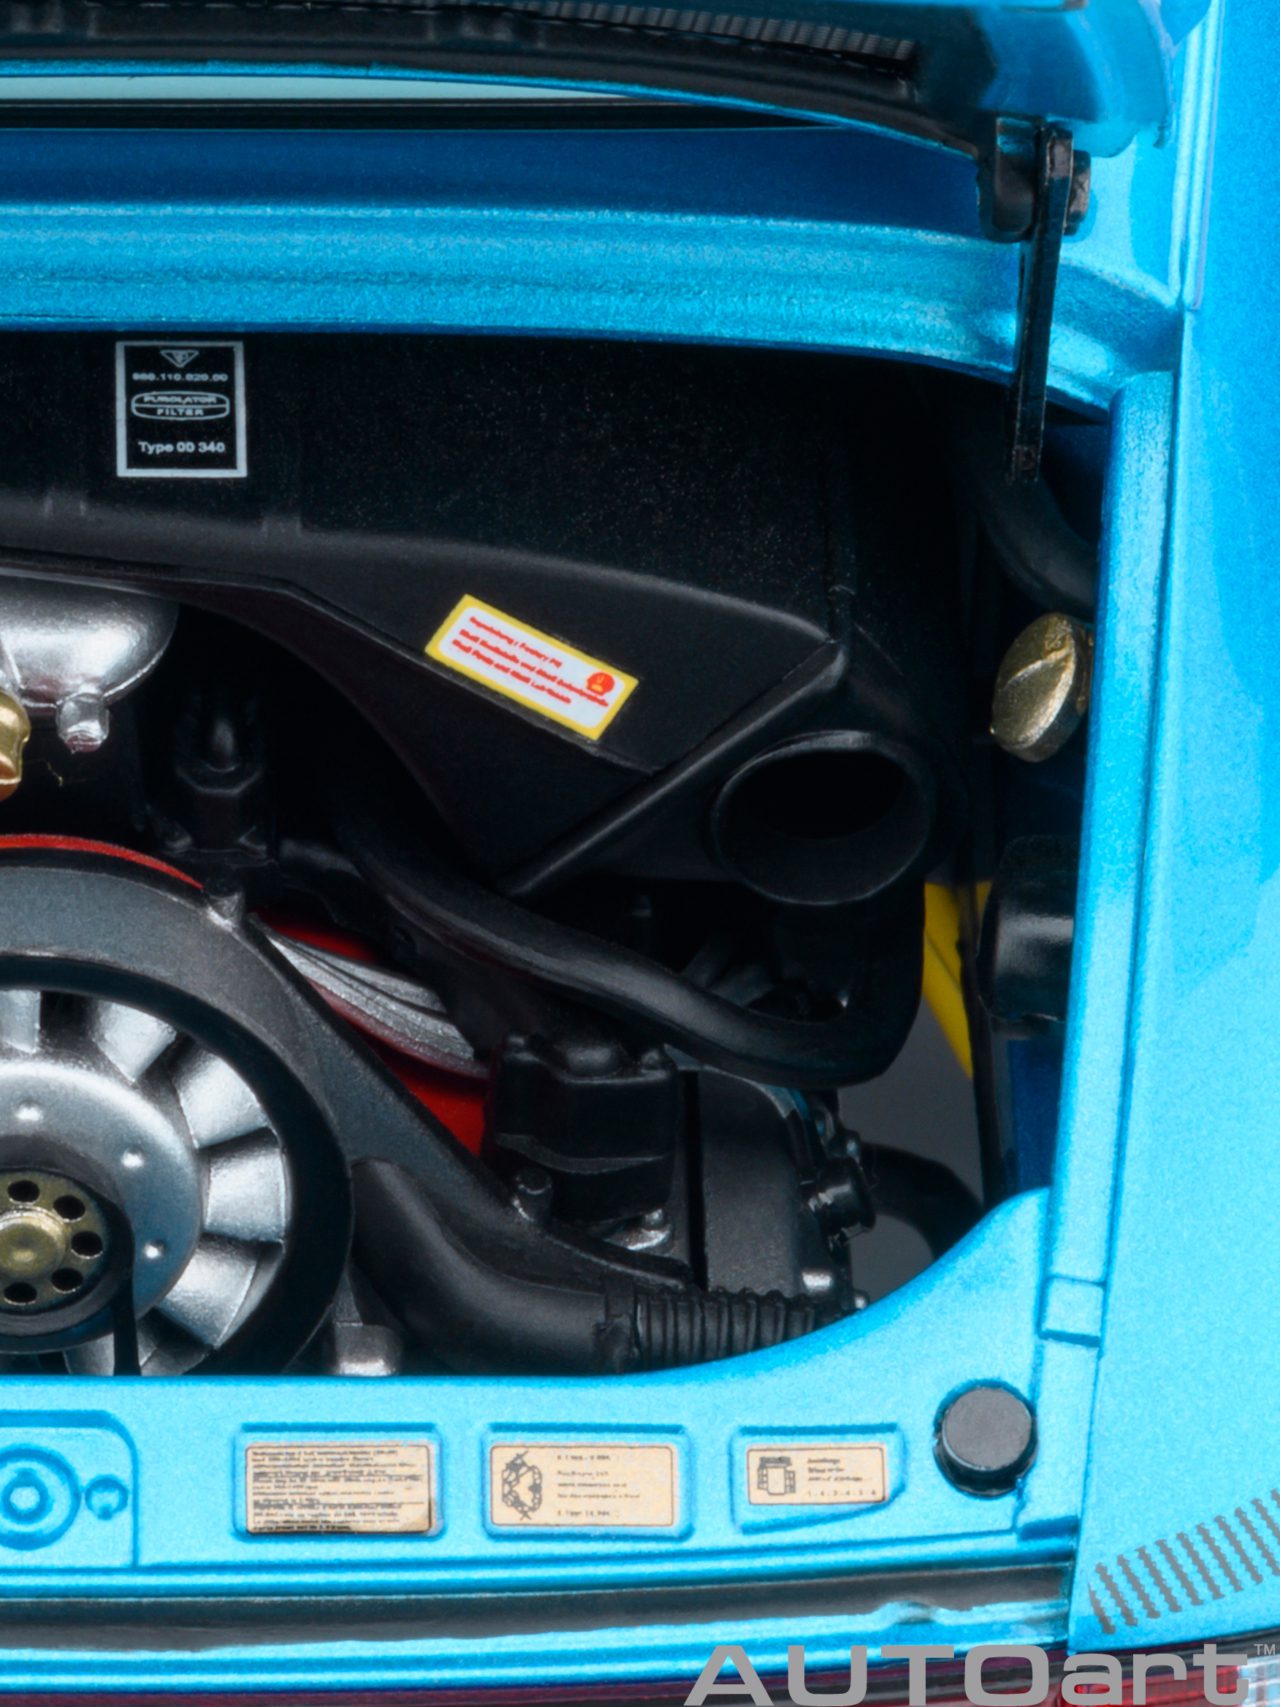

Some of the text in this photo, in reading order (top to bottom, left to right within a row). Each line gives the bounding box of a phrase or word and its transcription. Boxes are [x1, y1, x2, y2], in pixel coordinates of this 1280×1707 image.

[156, 408, 205, 416] FILTER
[138, 441, 174, 455] Type
[198, 441, 226, 453] 340
